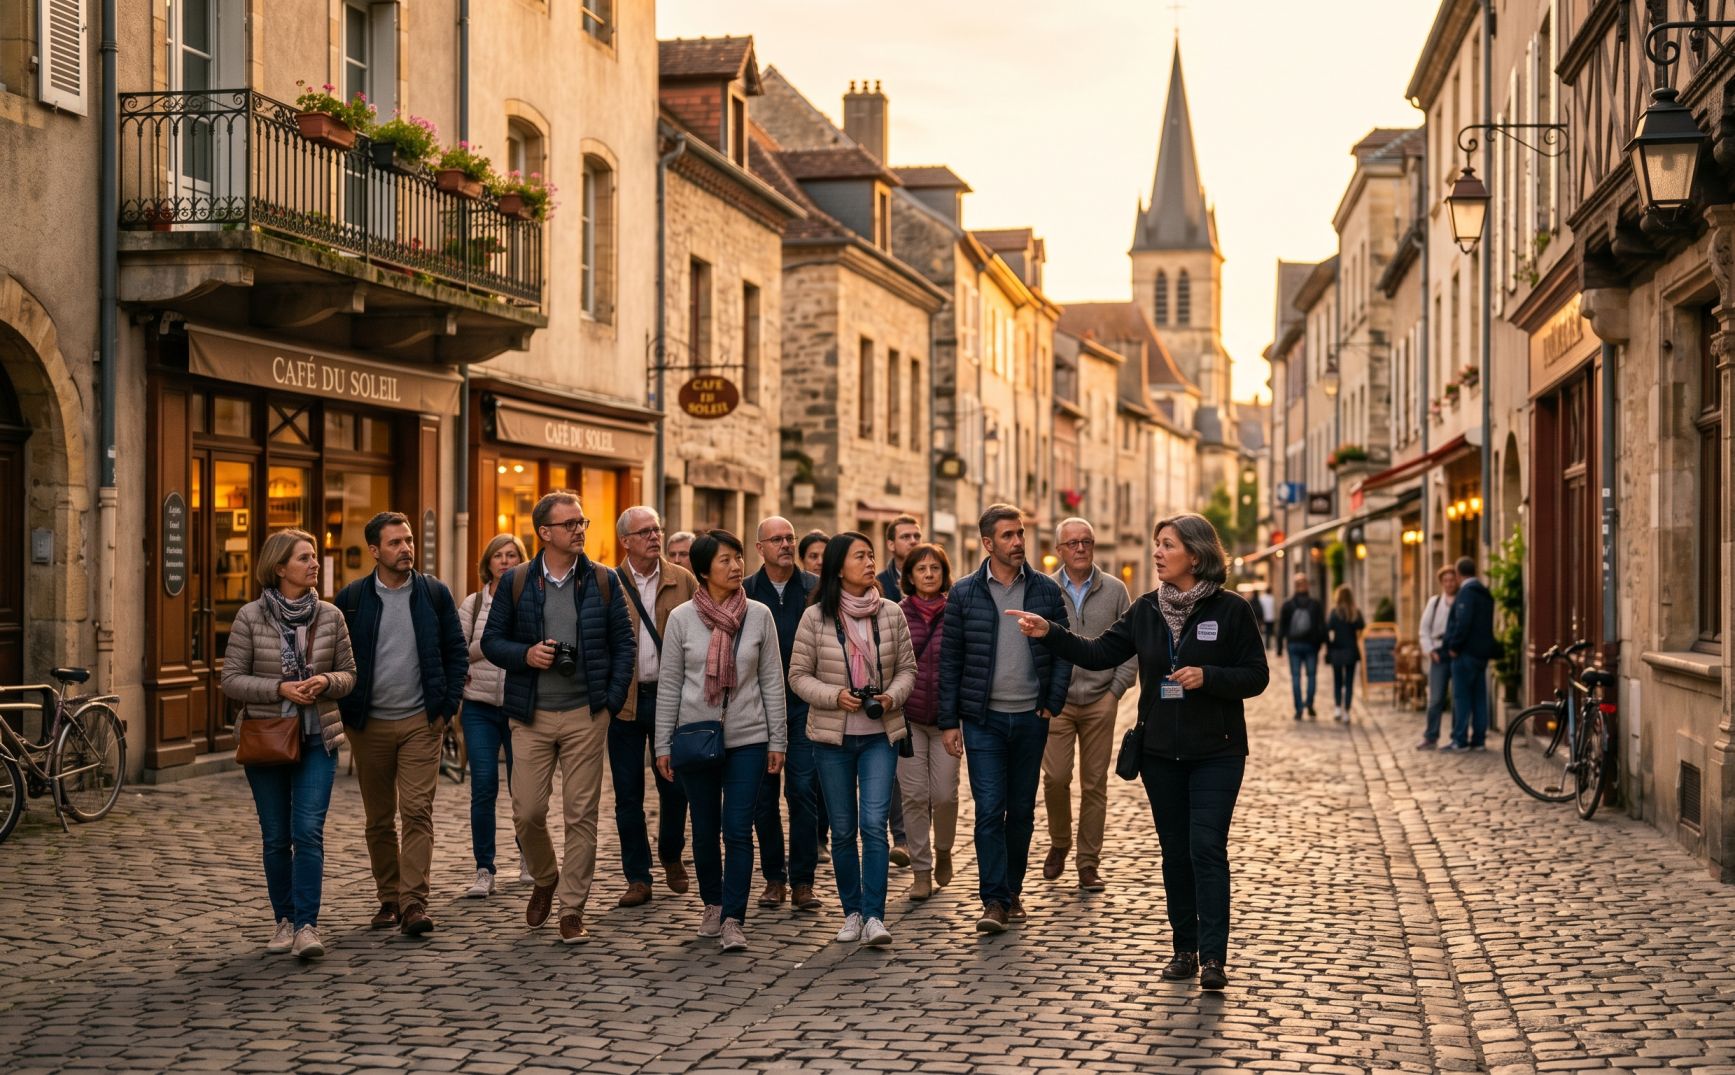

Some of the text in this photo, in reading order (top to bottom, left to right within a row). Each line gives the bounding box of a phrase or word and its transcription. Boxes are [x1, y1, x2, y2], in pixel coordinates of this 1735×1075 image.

[272, 355, 400, 402] CAFÉ DU SOLEIL
[545, 420, 615, 453] CAFÉ DU SOLEIL
